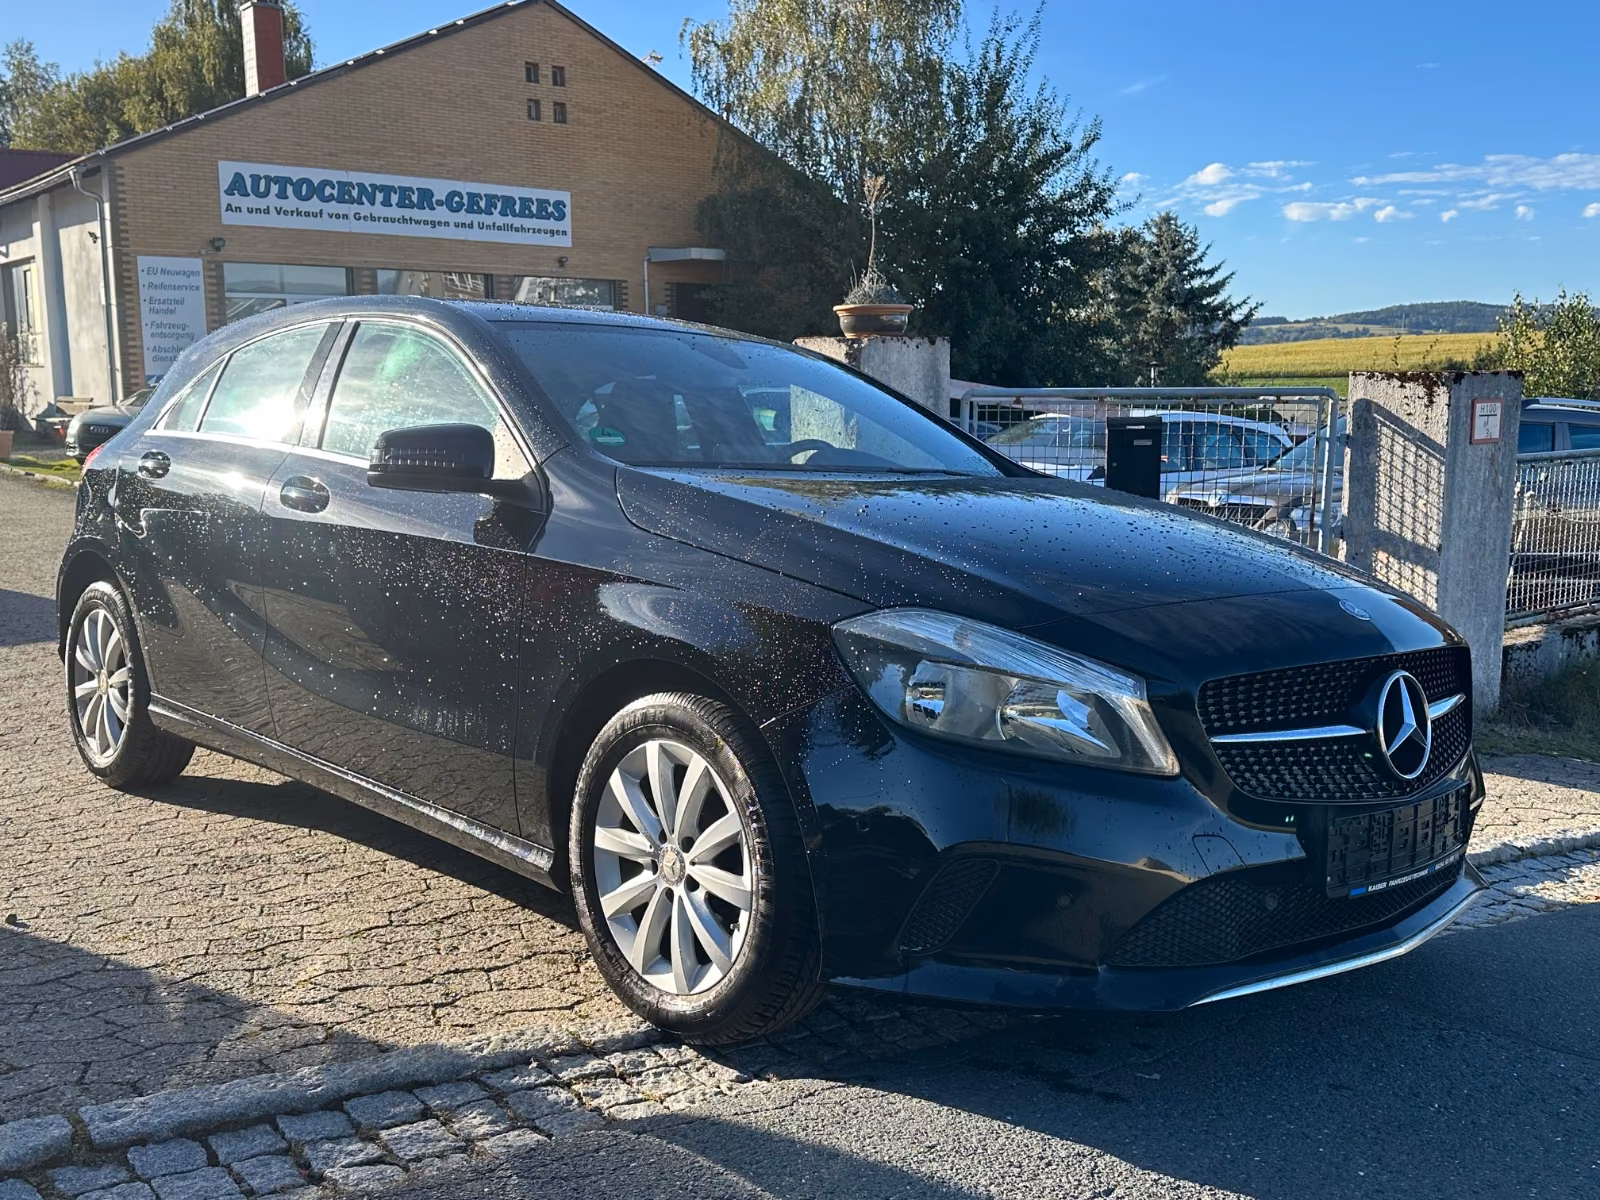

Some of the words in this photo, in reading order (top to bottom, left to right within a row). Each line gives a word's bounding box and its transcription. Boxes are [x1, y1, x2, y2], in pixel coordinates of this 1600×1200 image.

[223, 171, 567, 222] AUTOCENTER-GEFREES
[224, 203, 242, 213] An
[246, 205, 270, 215] und
[274, 206, 324, 219] Verkauf
[327, 211, 349, 221] von
[353, 211, 450, 229] Gebrauchtwagen
[453, 220, 474, 230] und
[477, 221, 568, 237] Unfallfahrzeugen
[146, 266, 159, 276] EU
[160, 267, 200, 279] Neuwagen
[147, 282, 200, 292] Reifenservice
[148, 296, 185, 306] Ersatzteil
[148, 306, 176, 315] Handel
[150, 321, 190, 332] Fahrzeug-
[150, 330, 195, 341] entsorgung
